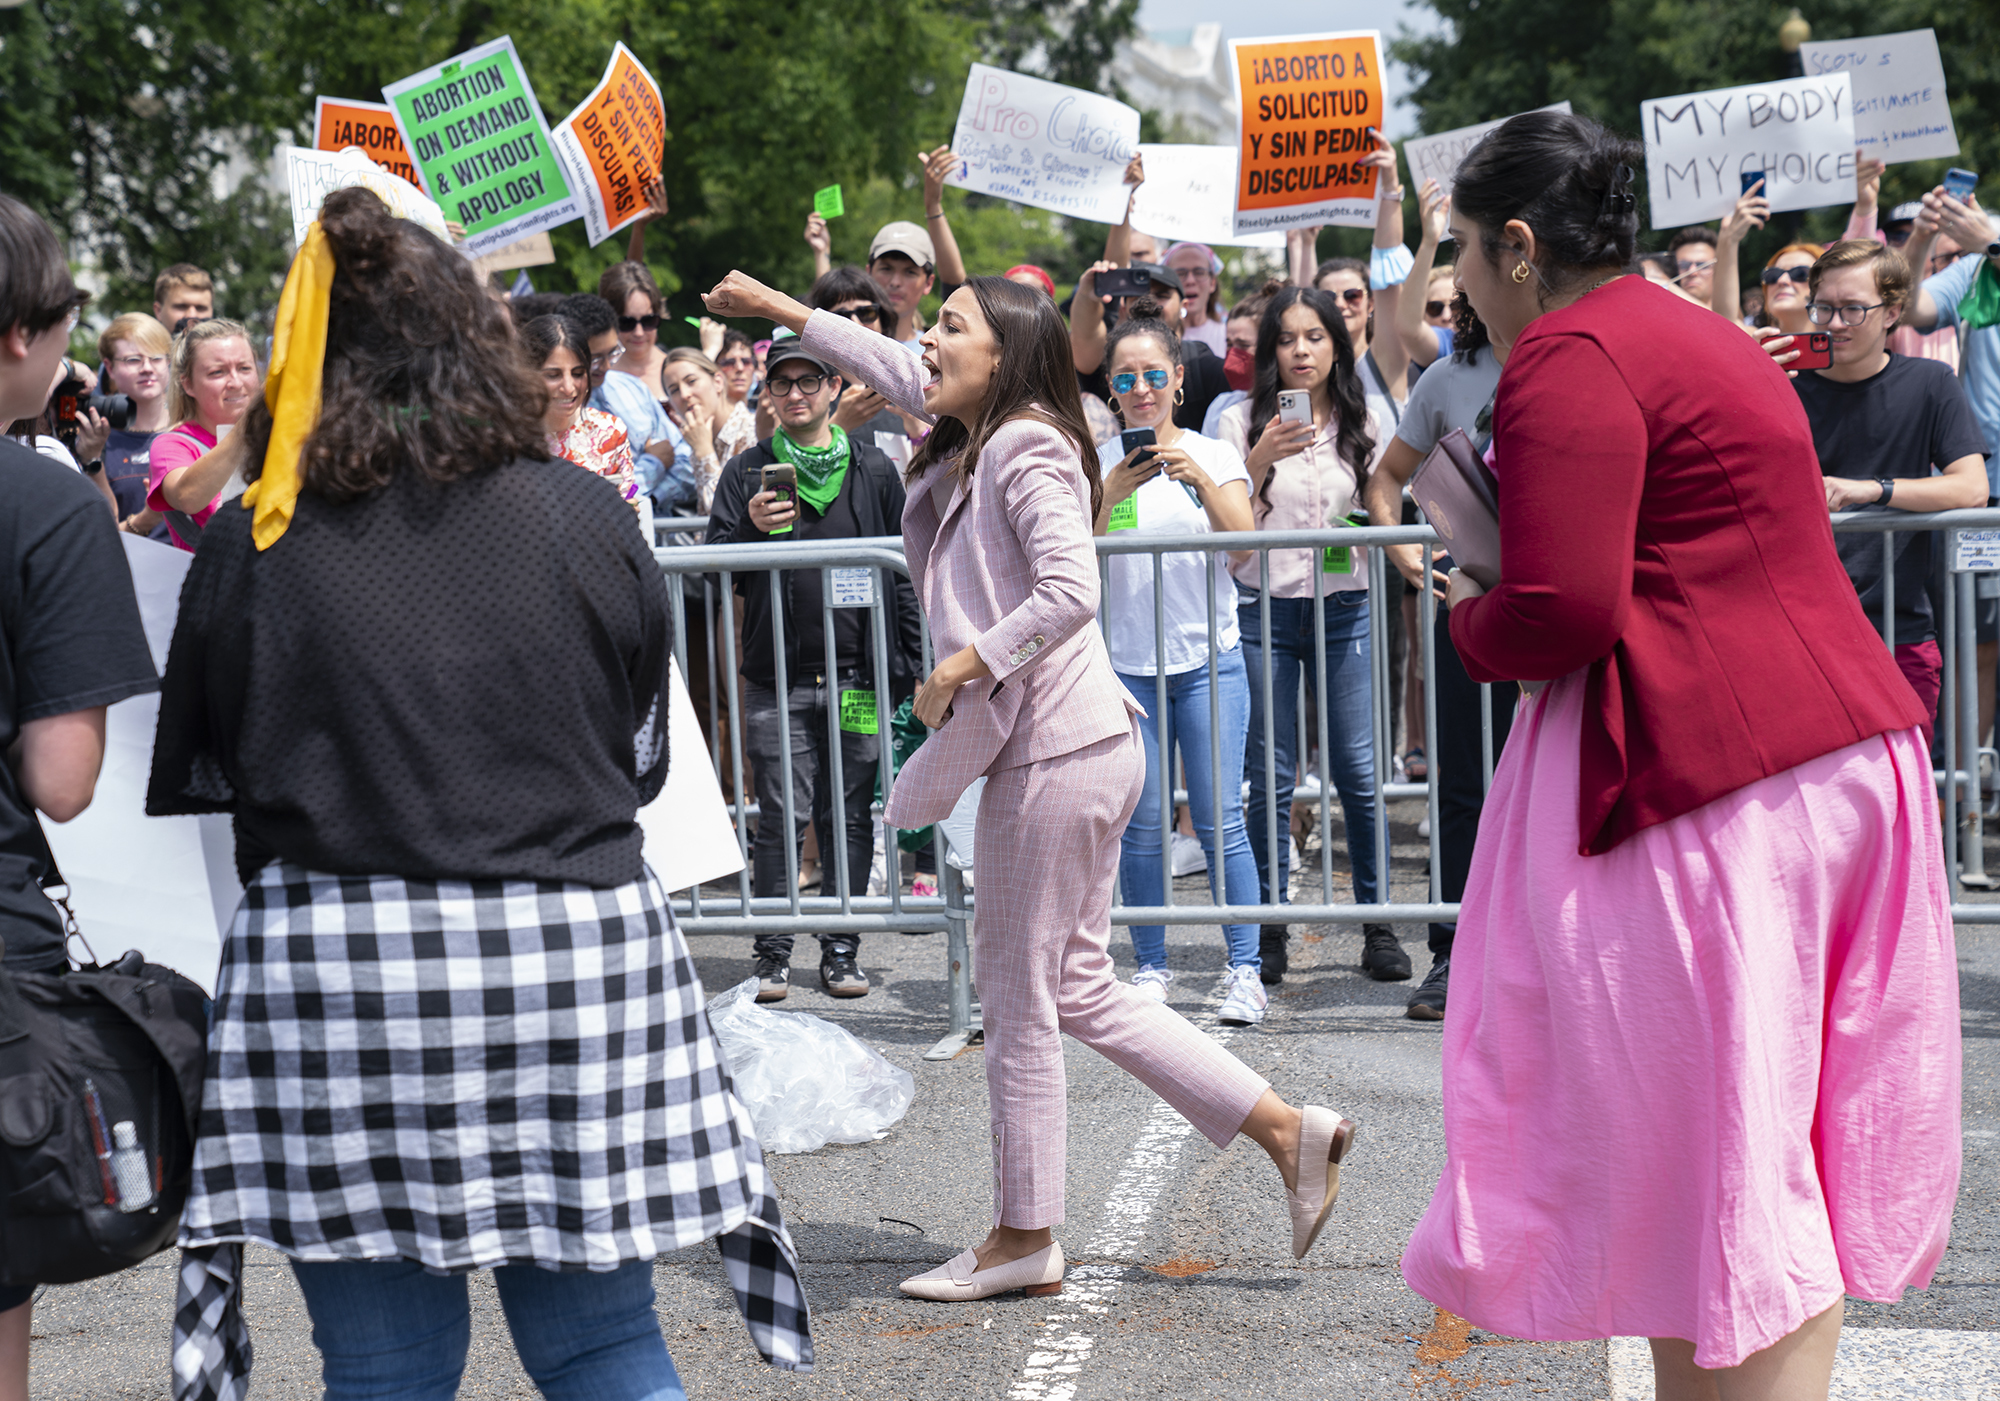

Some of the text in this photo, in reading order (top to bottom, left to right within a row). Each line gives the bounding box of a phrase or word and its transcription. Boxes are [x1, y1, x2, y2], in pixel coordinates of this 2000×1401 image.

[1354, 52, 1368, 78] A
[412, 64, 506, 124] ABORTION
[601, 91, 616, 110] Y
[609, 110, 633, 147] SIN
[973, 74, 1040, 141] Pro
[1258, 89, 1368, 121] SOLICITUD
[1653, 85, 1844, 146] MY BODY
[1853, 87, 1932, 116] GITIMATE
[415, 96, 531, 162] ON DEMAND
[616, 83, 663, 170] SOLICITU
[1250, 126, 1376, 160] Y SIN PEDIR
[436, 172, 451, 195] &
[452, 132, 540, 188] WITHOUT
[582, 112, 636, 218] DISCULPAS!
[1020, 147, 1035, 165] to
[1248, 161, 1371, 196] DISCULPAS!
[1664, 151, 1855, 200] MY CHOICE
[458, 169, 546, 227] APOLOGY
[847, 692, 875, 701] ABORTIO
